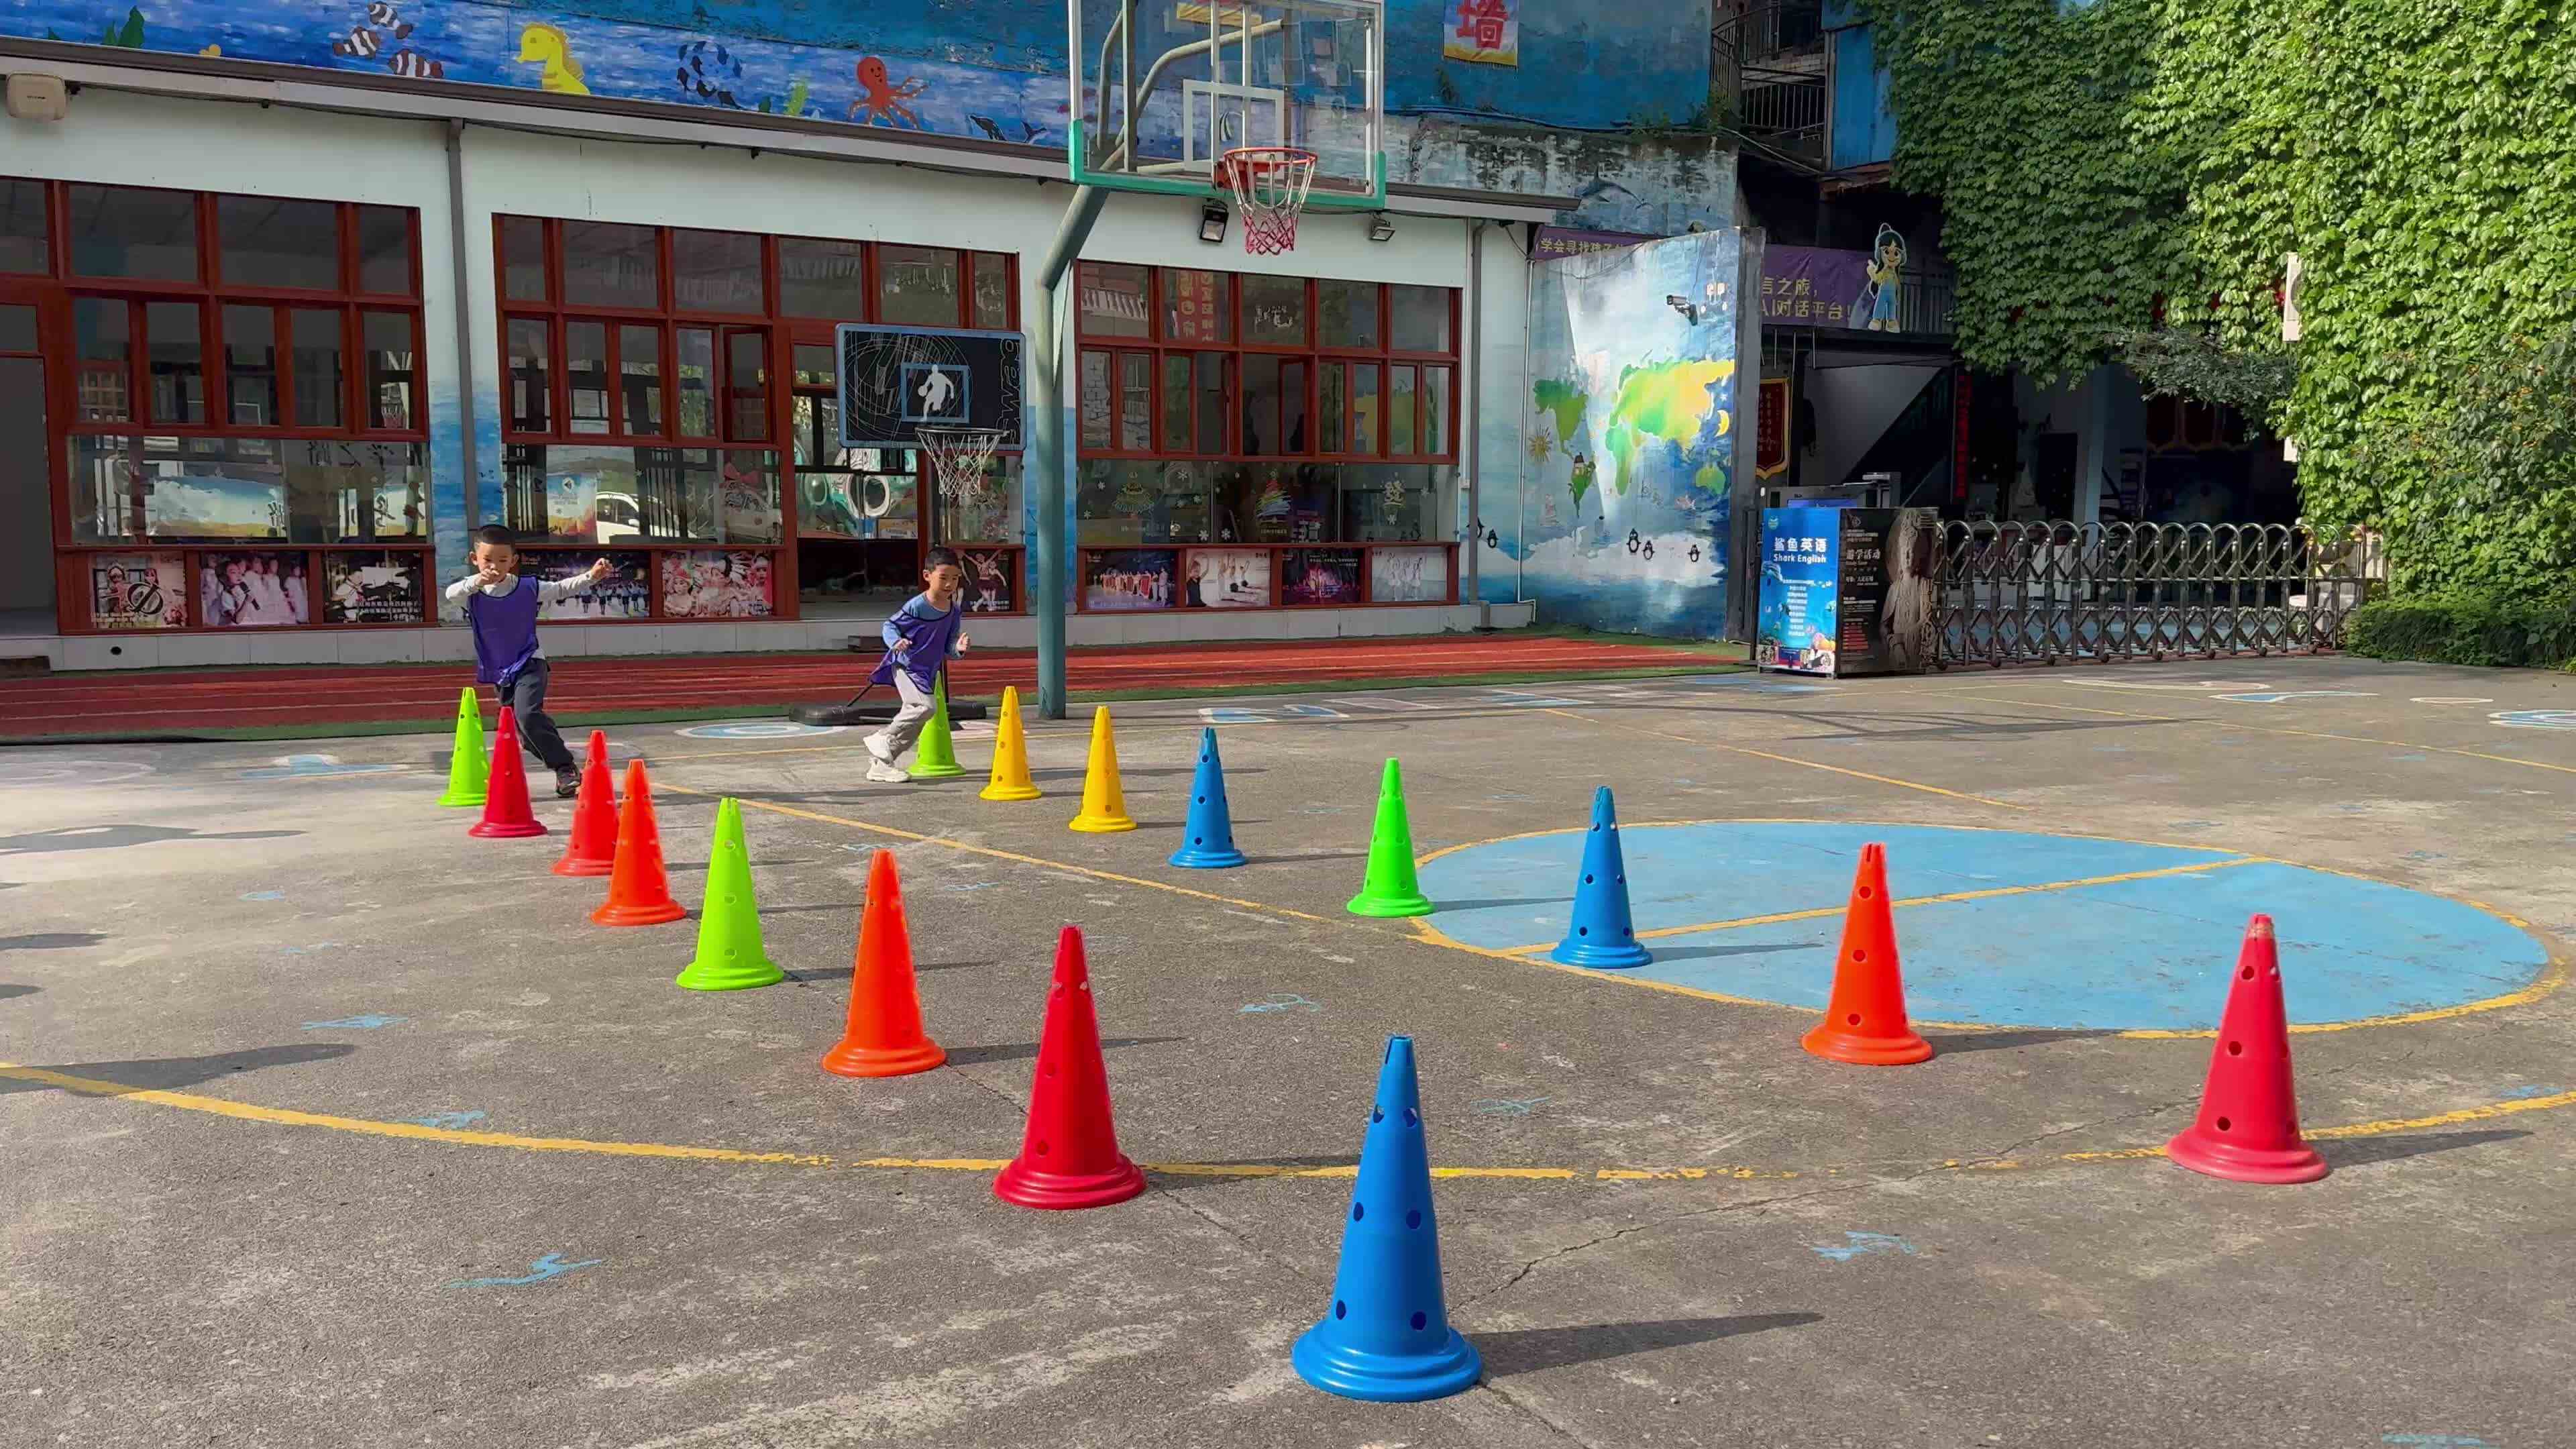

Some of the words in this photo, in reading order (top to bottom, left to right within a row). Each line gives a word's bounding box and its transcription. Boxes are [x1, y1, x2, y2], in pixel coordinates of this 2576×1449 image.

[1540, 237, 1623, 254] 学会寻找孩子
[1774, 537, 1827, 553] 鲨鱼英语
[1773, 553, 1795, 563] Shark
[1797, 553, 1827, 565] English
